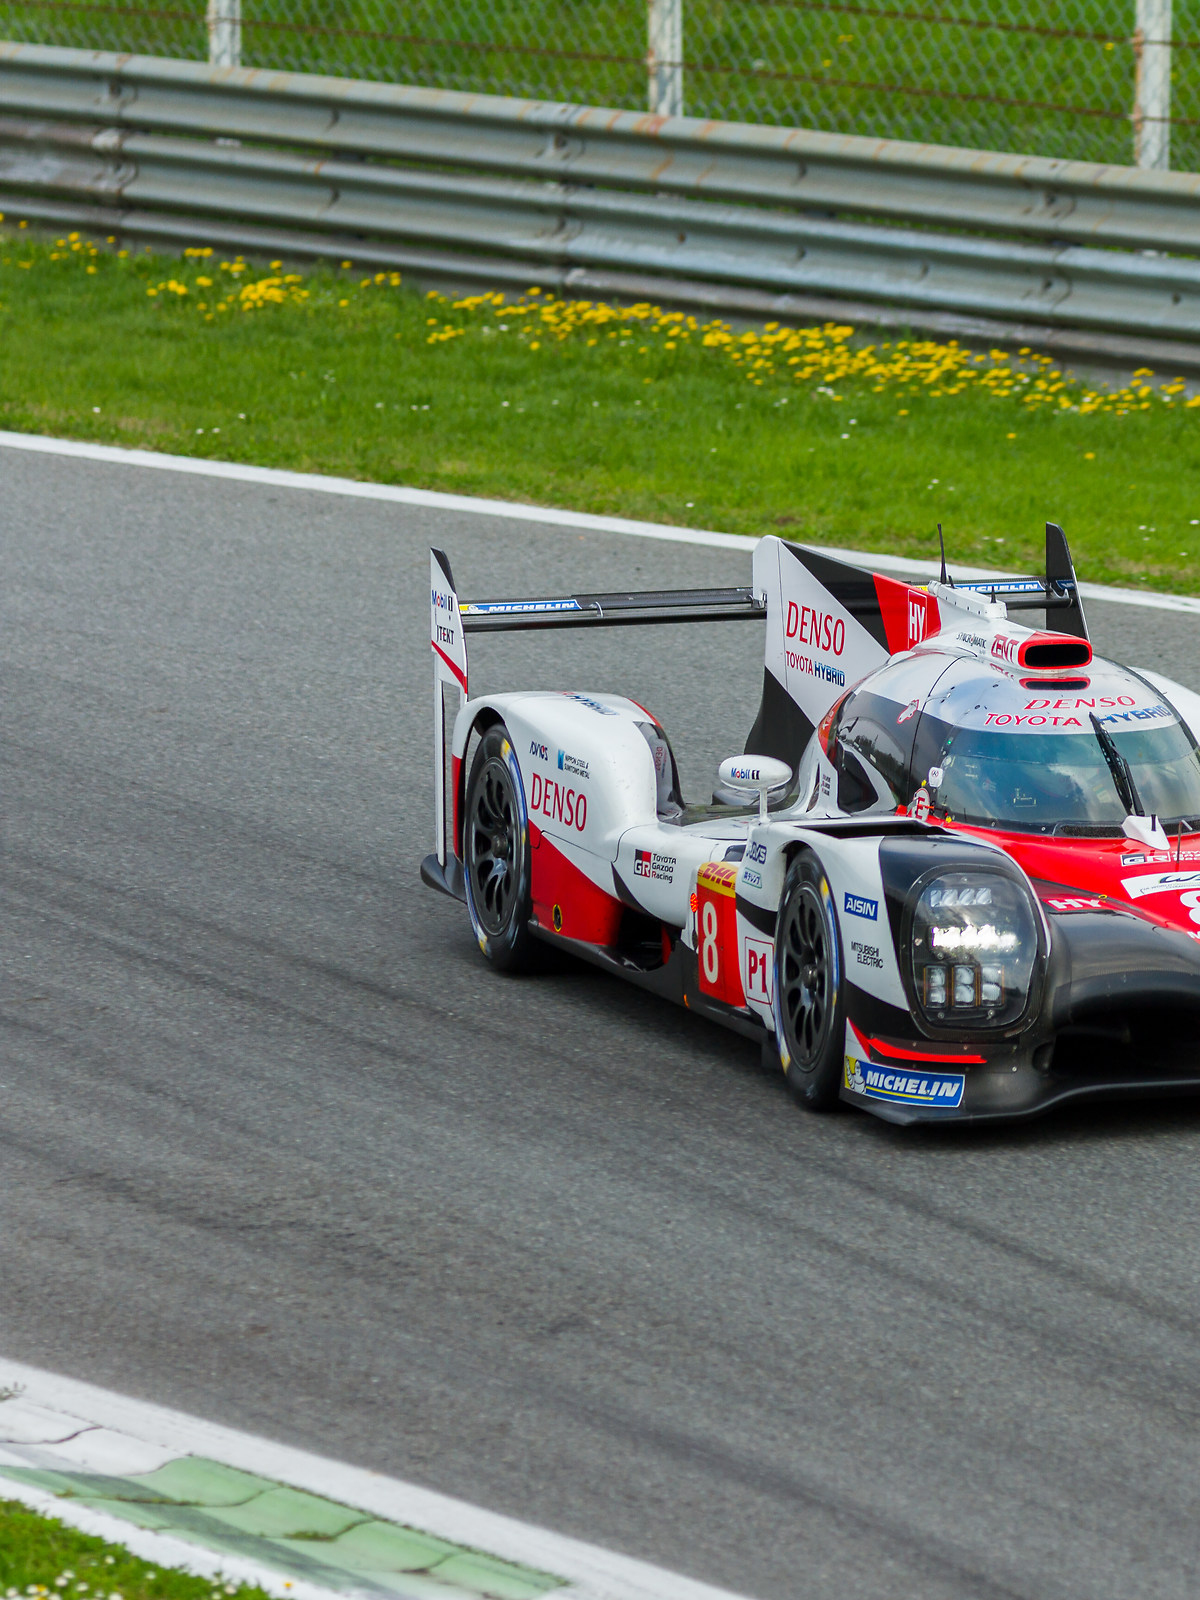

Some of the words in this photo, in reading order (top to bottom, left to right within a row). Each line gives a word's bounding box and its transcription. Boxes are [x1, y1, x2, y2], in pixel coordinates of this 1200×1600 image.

[431, 589, 447, 609] Mobil
[488, 602, 576, 613] MICHELIN
[786, 600, 846, 657] DENSO
[908, 600, 926, 643] HY
[436, 625, 455, 645] JTEKT
[785, 650, 814, 676] TOYOTA
[814, 660, 846, 687] HYBRID
[1023, 695, 1137, 710] DENSO
[984, 712, 1083, 727] TOYOTA
[1096, 704, 1173, 726] HYBRID
[730, 767, 750, 780] Mobil
[530, 772, 588, 832] DENSO
[634, 858, 651, 877] GR
[651, 862, 674, 873] GAZOO
[652, 853, 677, 865] TOYOTA
[1122, 854, 1170, 866] GR
[651, 870, 673, 884] Racing
[702, 862, 737, 888] DHL
[845, 897, 876, 917] AISIN
[1047, 898, 1102, 909] HY
[702, 901, 719, 984] 8
[850, 941, 880, 957] MITSUBISHI
[748, 949, 767, 993] P1
[856, 953, 884, 969] ELECTRIC
[865, 1070, 961, 1098] MICHELIN
